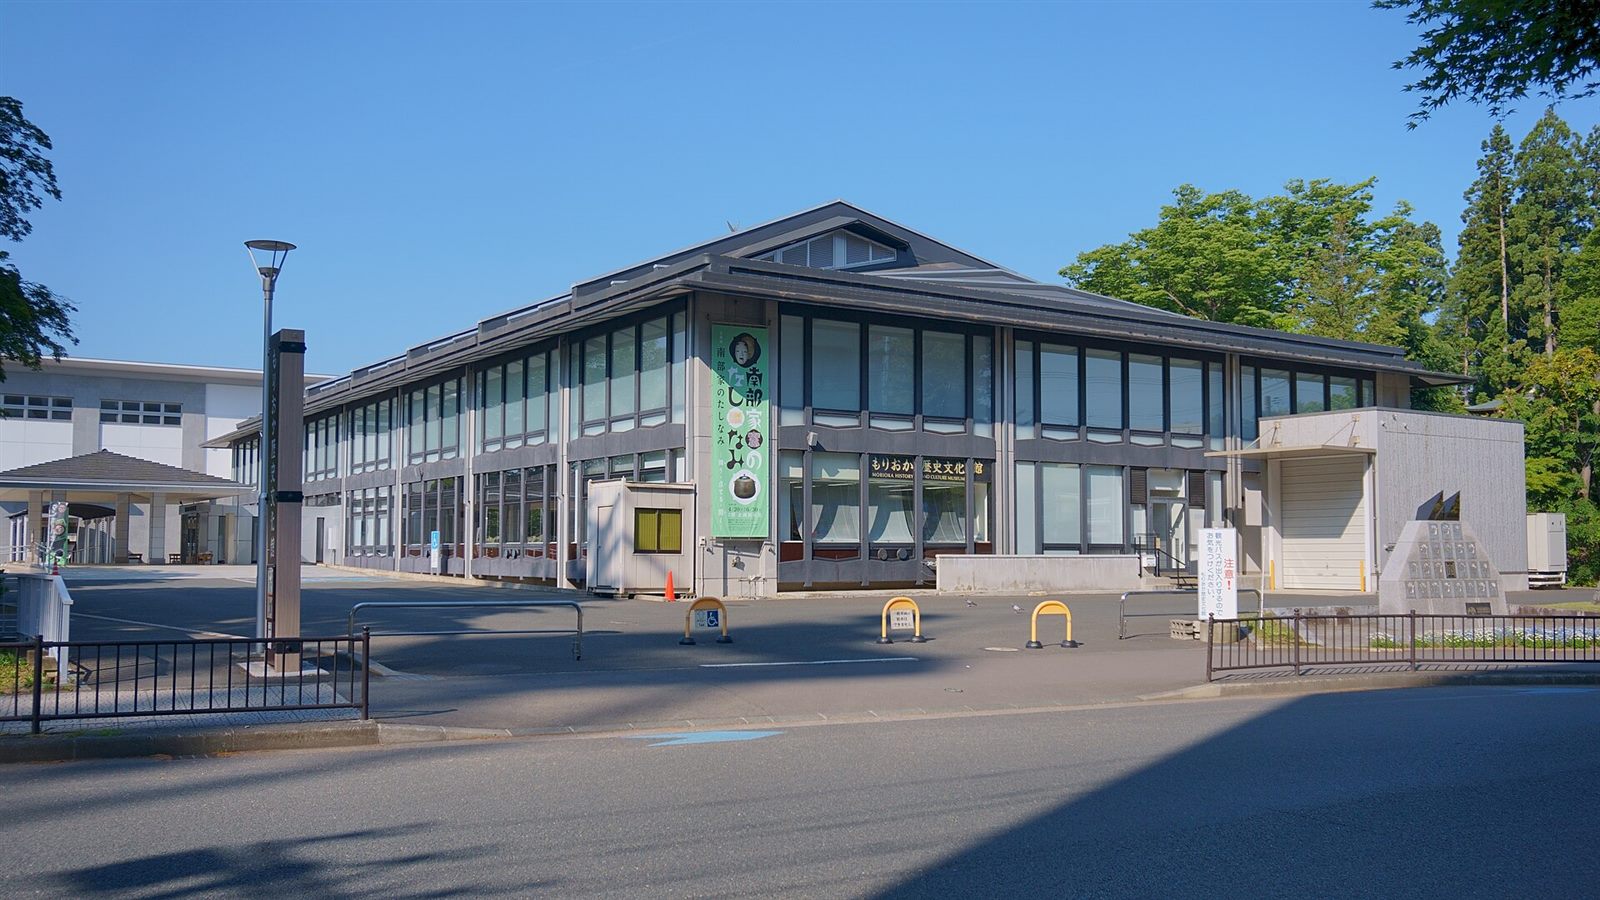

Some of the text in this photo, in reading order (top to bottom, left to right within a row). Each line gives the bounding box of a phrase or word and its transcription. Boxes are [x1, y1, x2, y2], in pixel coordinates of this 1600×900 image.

[716, 347, 726, 446] 南部家のたしなみ
[1215, 533, 1223, 616] 観光バスが出入りするので
